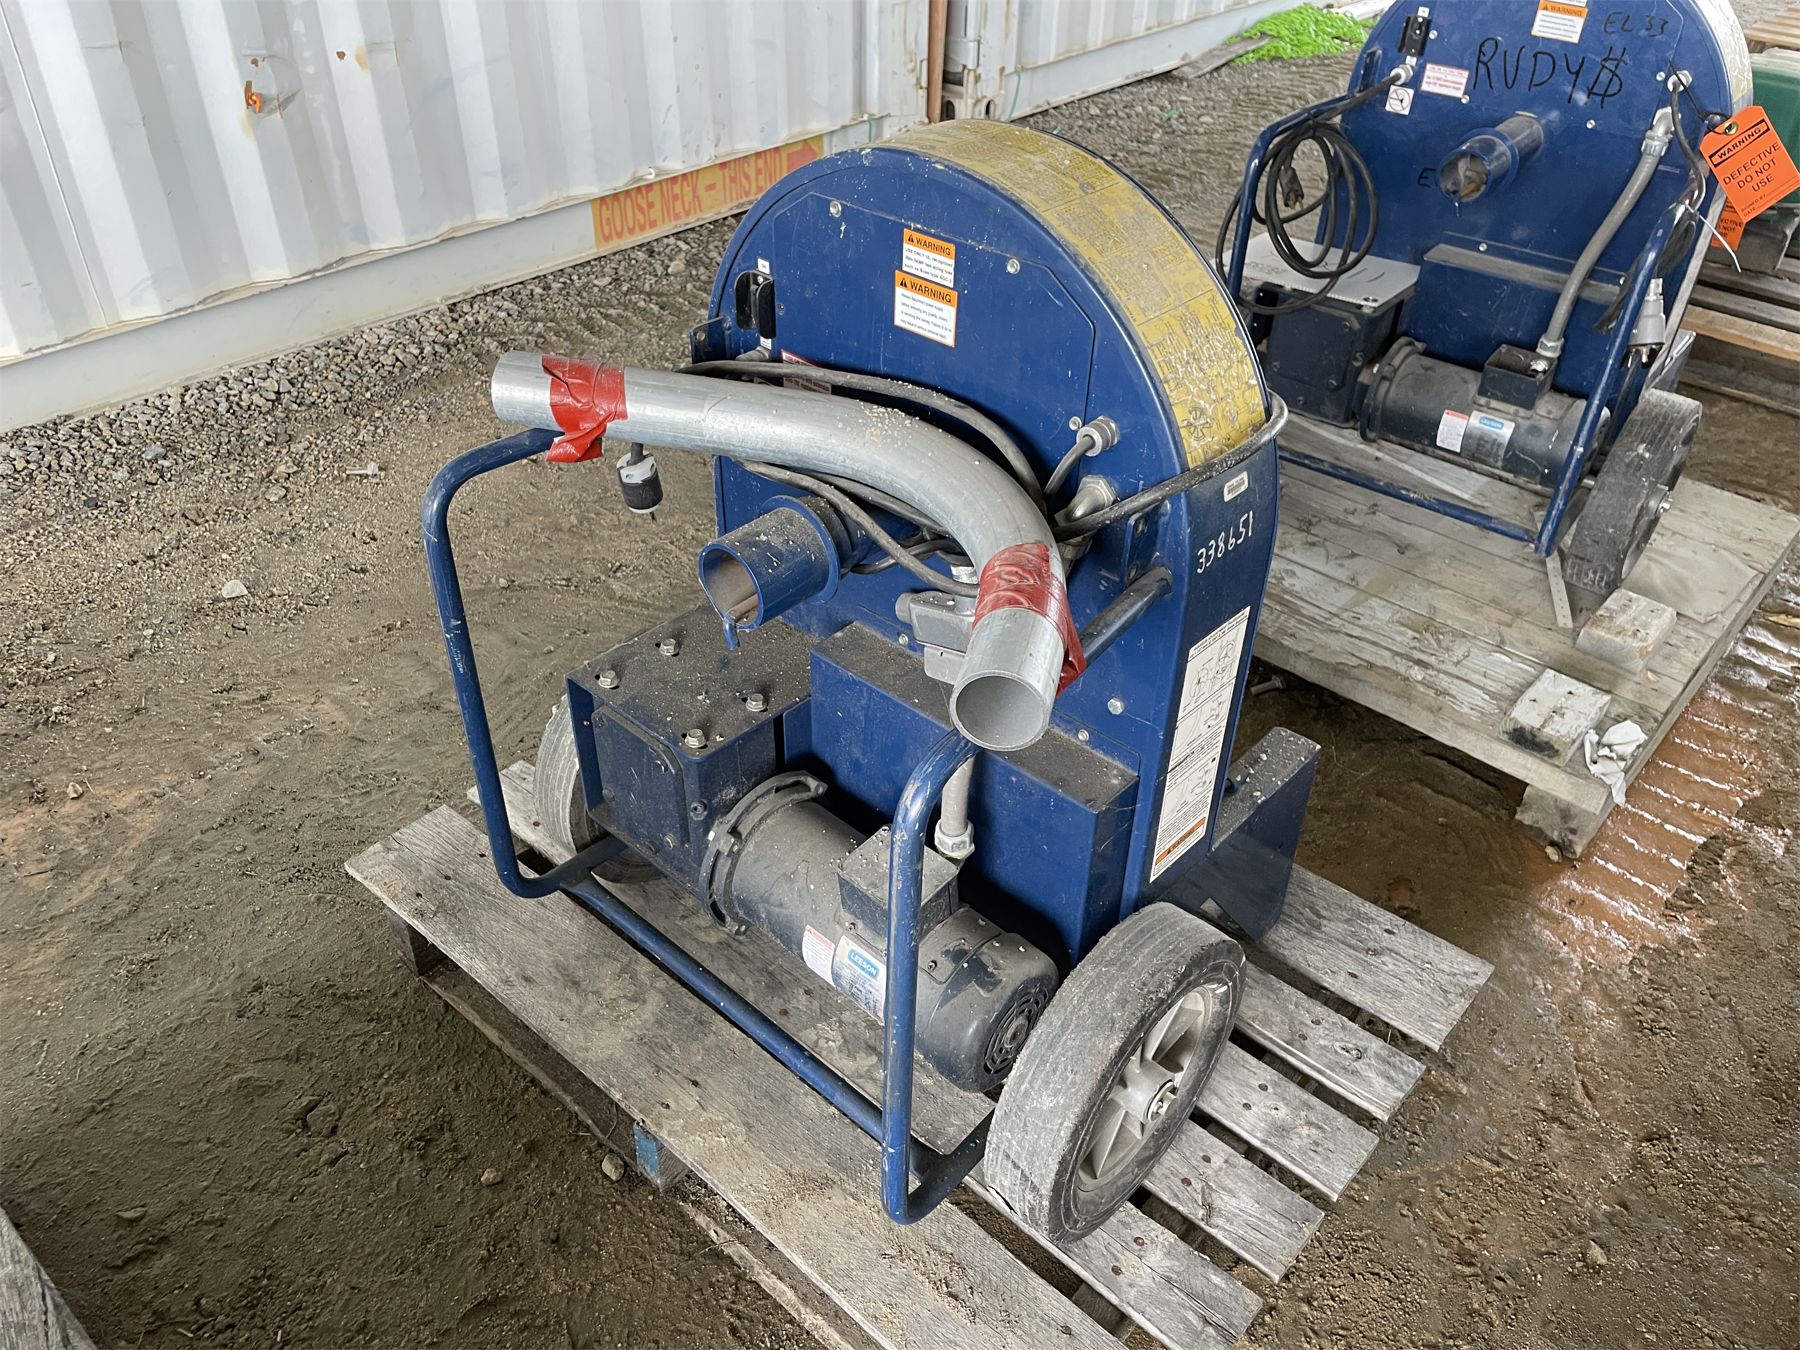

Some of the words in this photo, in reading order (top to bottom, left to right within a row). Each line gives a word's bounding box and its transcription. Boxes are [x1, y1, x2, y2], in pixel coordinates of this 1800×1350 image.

[1717, 127, 1761, 159] WARNING
[1723, 142, 1781, 185] DEFECTIVE
[1737, 174, 1754, 189] DO
[1755, 158, 1777, 177] NOT
[599, 184, 657, 244] GOOSE
[660, 171, 703, 225] NECK
[719, 162, 751, 203] THIS
[754, 147, 782, 195] END
[1751, 174, 1775, 192] USE
[915, 236, 951, 256] WARNING
[910, 280, 952, 304] WARNING
[1196, 509, 1254, 574] 338651
[850, 951, 878, 976] LEESON
